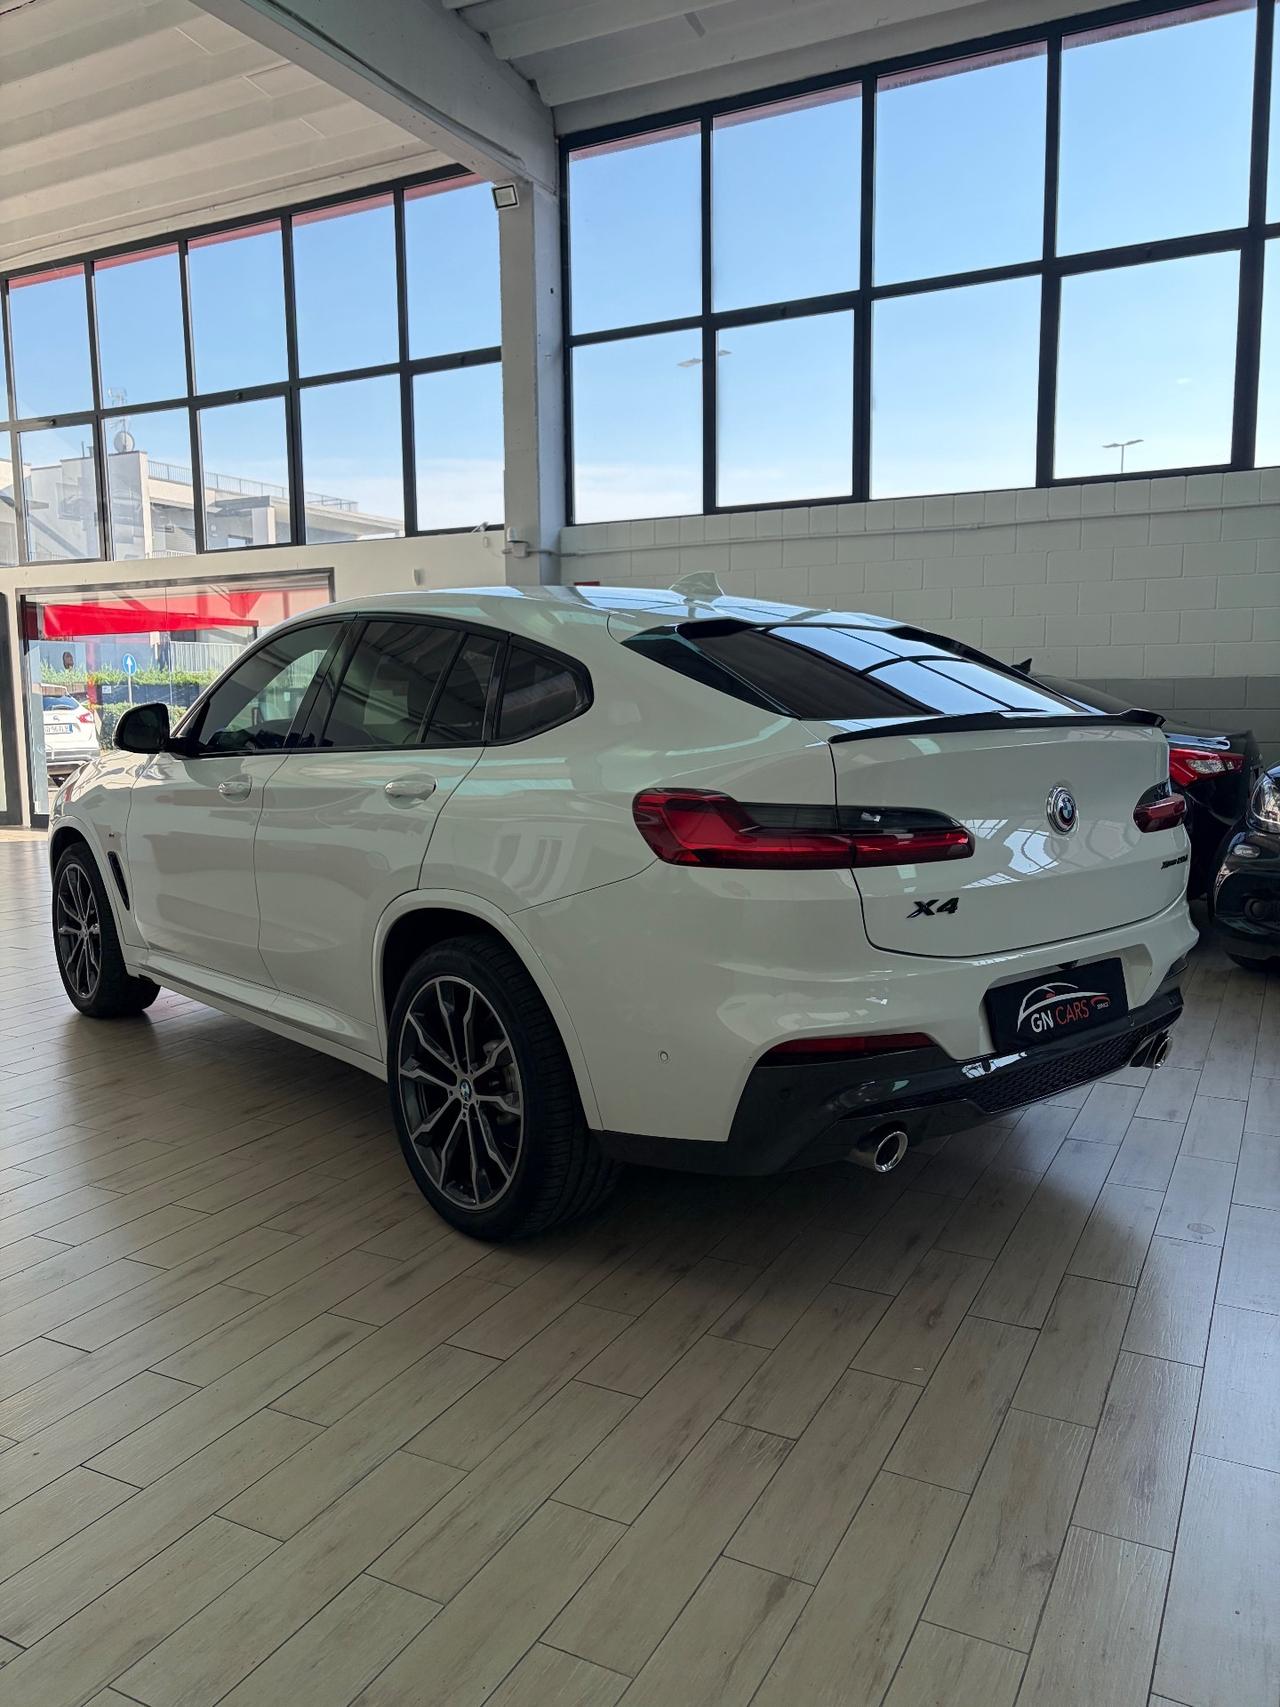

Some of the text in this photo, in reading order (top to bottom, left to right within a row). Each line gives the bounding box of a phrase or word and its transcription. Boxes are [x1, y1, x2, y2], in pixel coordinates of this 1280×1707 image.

[906, 897, 960, 919] X4
[1030, 999, 1090, 1033] GN CARS
